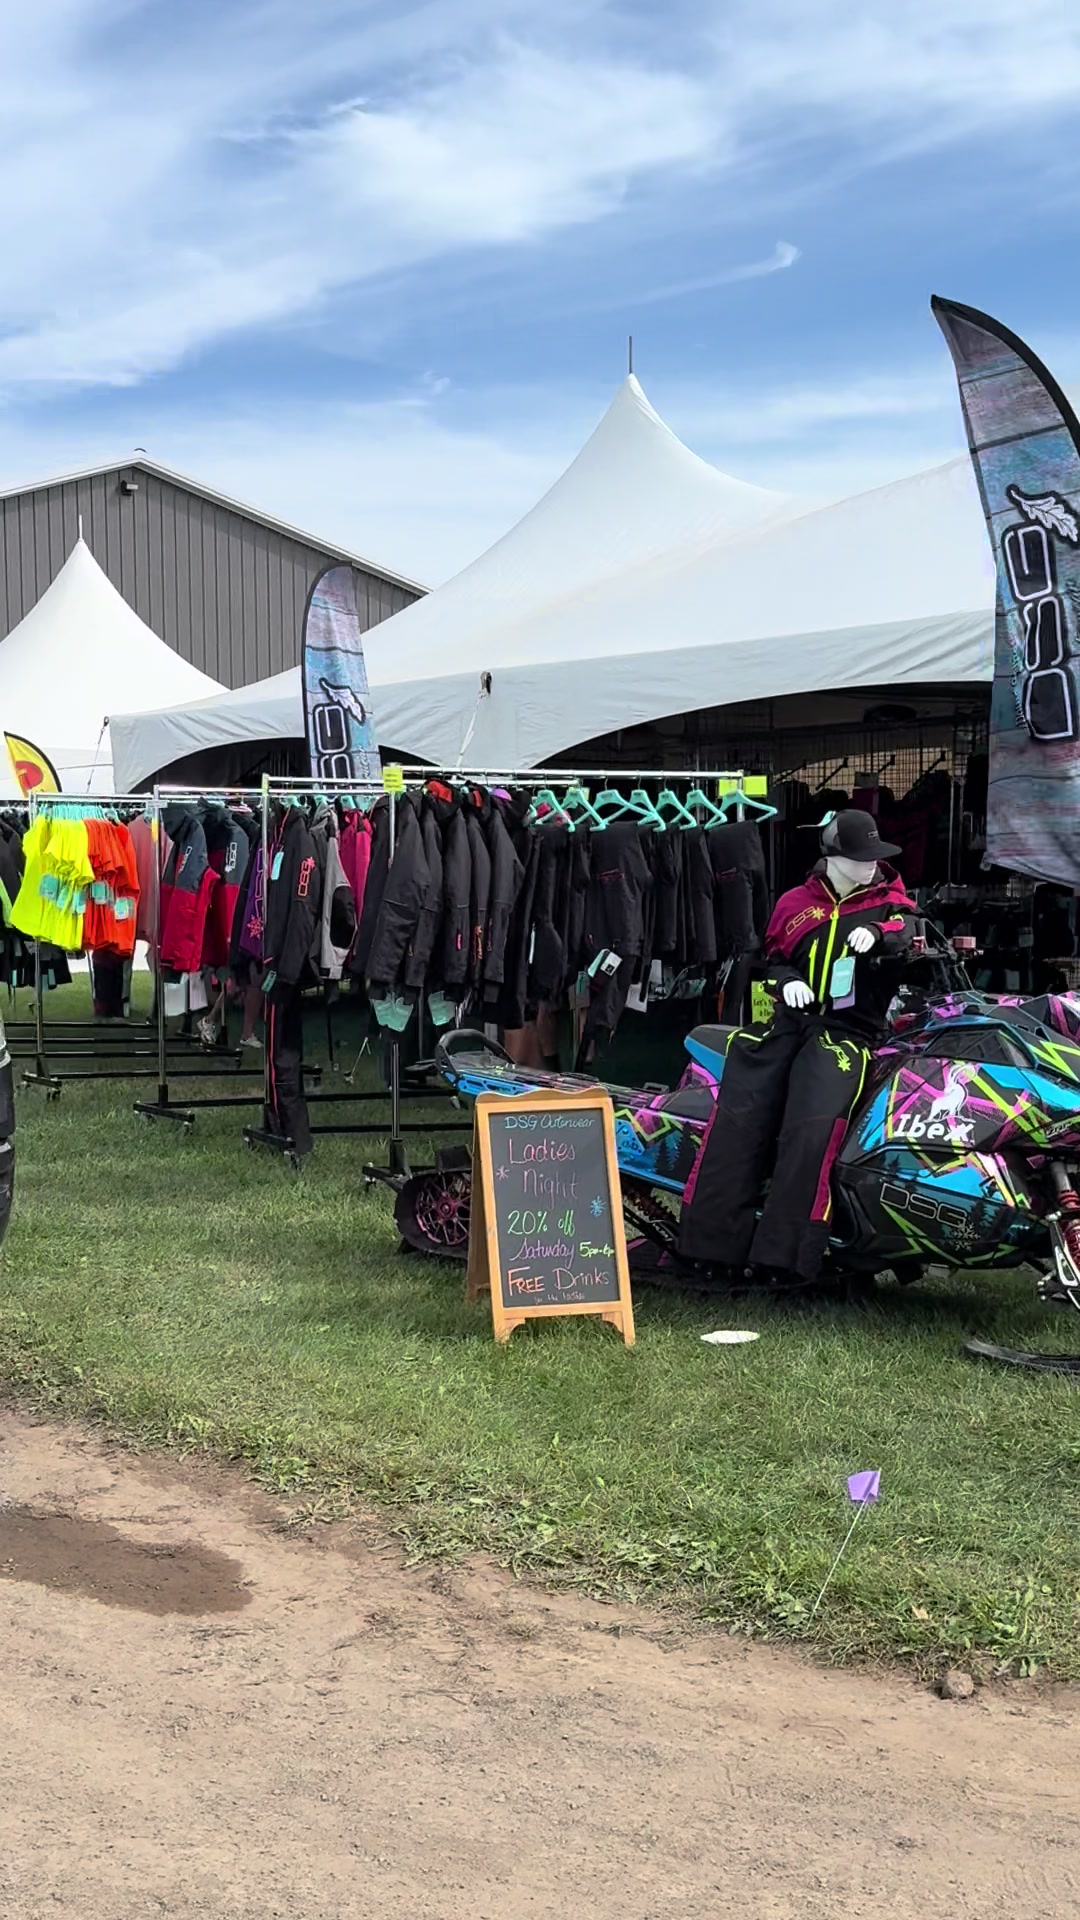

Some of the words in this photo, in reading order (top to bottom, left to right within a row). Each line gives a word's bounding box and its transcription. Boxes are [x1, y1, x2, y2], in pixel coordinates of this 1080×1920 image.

[1005, 524, 1074, 741] DSG
[504, 1115, 538, 1130] DSG
[540, 1114, 596, 1128] Outerwear
[893, 1114, 974, 1142] Ibex
[508, 1138, 576, 1164] Ladies
[523, 1168, 578, 1211] Night
[880, 1183, 967, 1229] DSG
[507, 1210, 548, 1235] 20%
[557, 1210, 576, 1237] off
[509, 1237, 575, 1269] Saturday
[507, 1266, 545, 1296] FREE
[552, 1267, 610, 1290] Drinks
